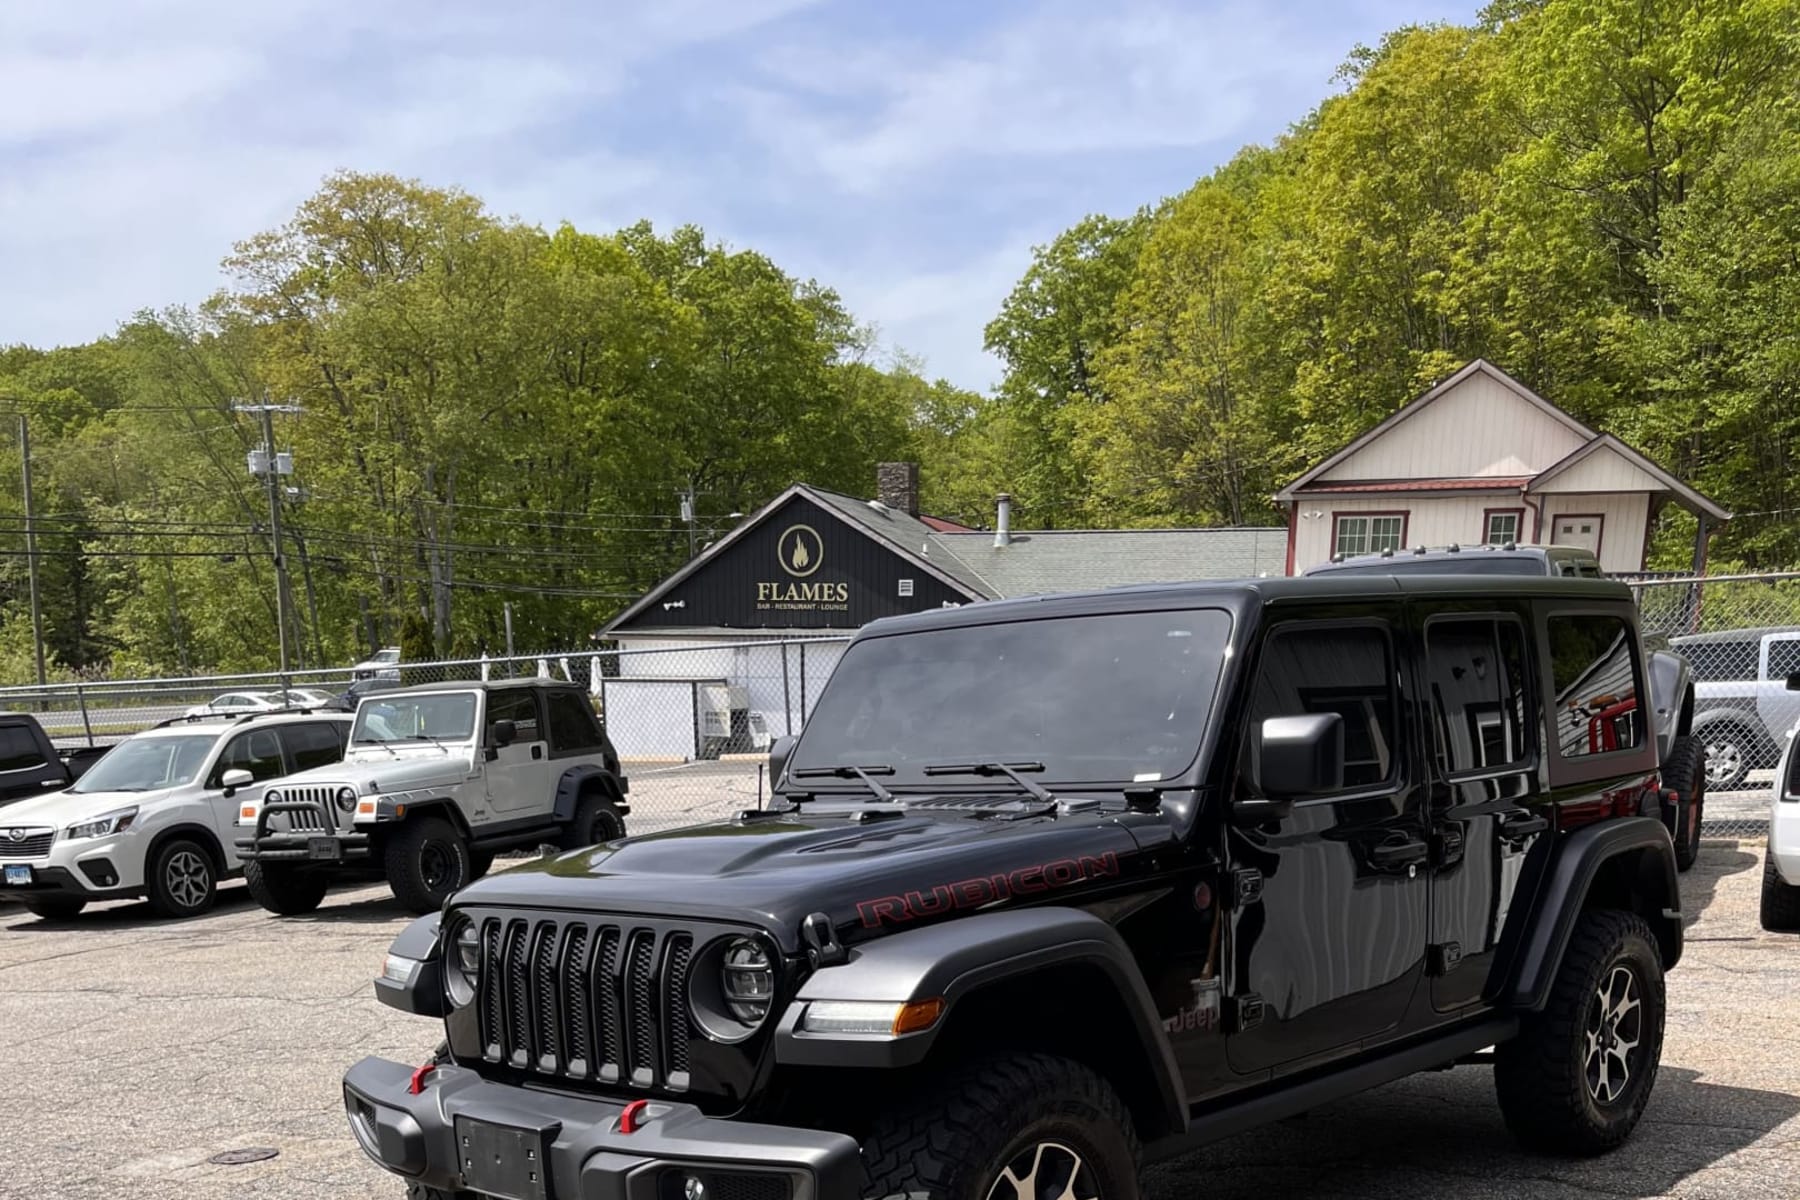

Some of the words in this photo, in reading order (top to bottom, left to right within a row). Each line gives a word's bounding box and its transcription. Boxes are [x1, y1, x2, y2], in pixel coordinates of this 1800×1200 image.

[757, 582, 848, 602] FLAMES
[775, 603, 816, 611] RESTAURANT
[821, 603, 848, 611] LOUNGE
[857, 850, 1120, 928] RUBICON
[1169, 1008, 1217, 1032] Jeep
